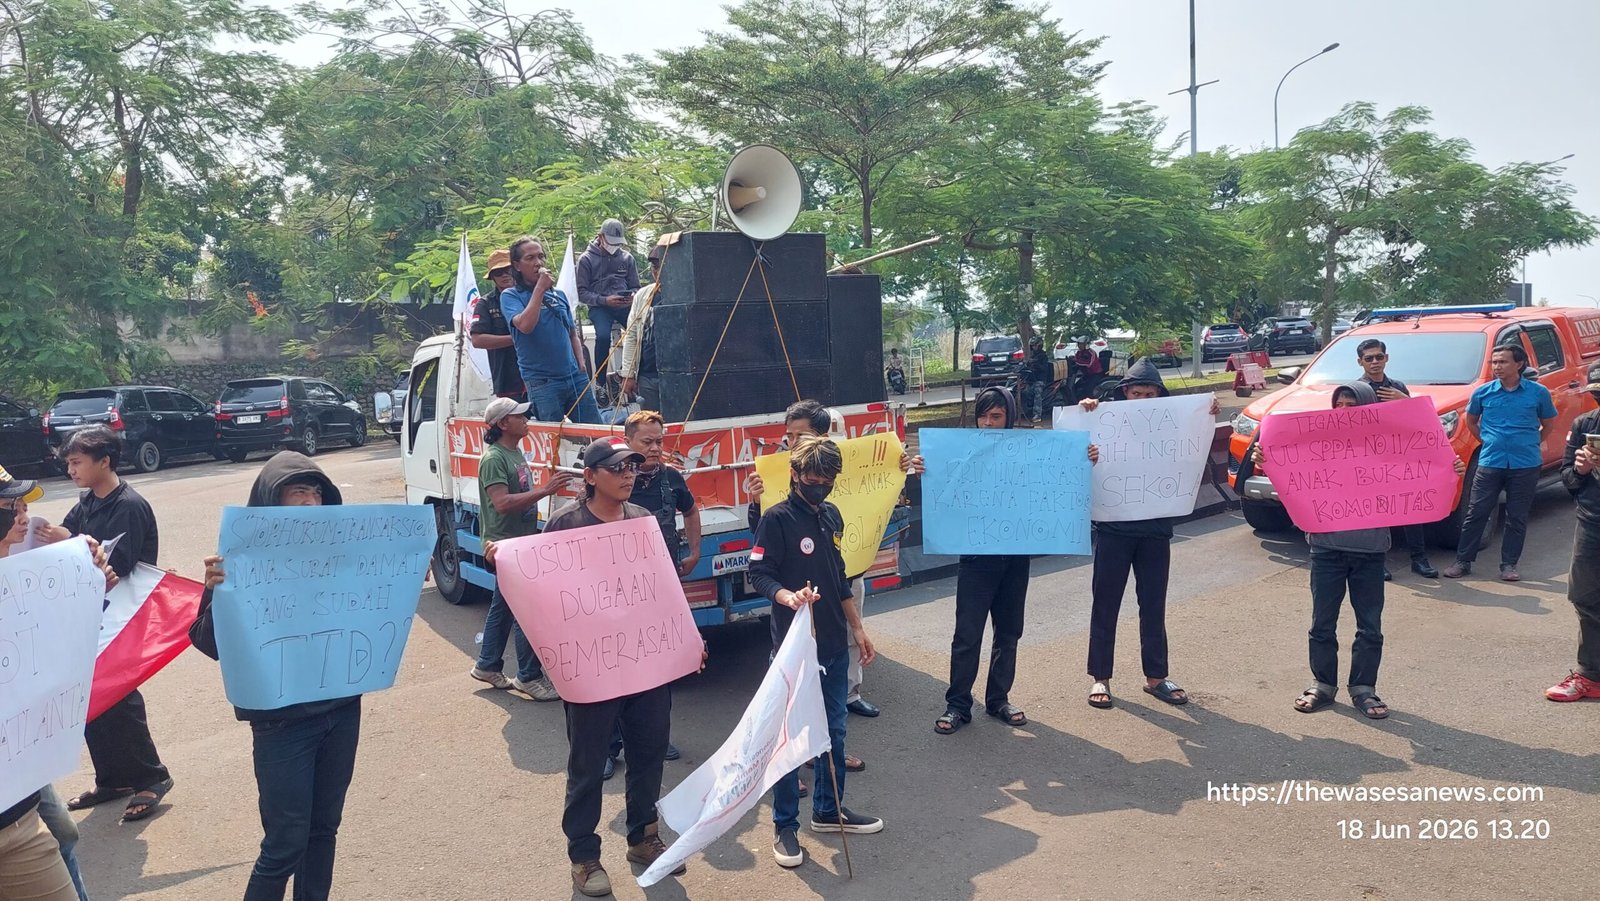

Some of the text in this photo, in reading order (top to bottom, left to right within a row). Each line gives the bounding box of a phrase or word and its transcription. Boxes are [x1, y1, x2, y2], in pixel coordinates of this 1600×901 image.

[1097, 408, 1179, 440] SAYA
[1288, 408, 1380, 434] TEGAKKAN
[1142, 436, 1200, 463] INGIN
[858, 472, 895, 494] ANAK
[1286, 460, 1432, 495] ANAK BUKAN
[931, 488, 1017, 510] KARENA
[967, 515, 1085, 546] EKONOMI
[356, 553, 420, 577] DAMAI
[514, 537, 586, 580] USUT
[248, 584, 393, 629] YANG SUDAH
[560, 572, 657, 622] DUGAAN
